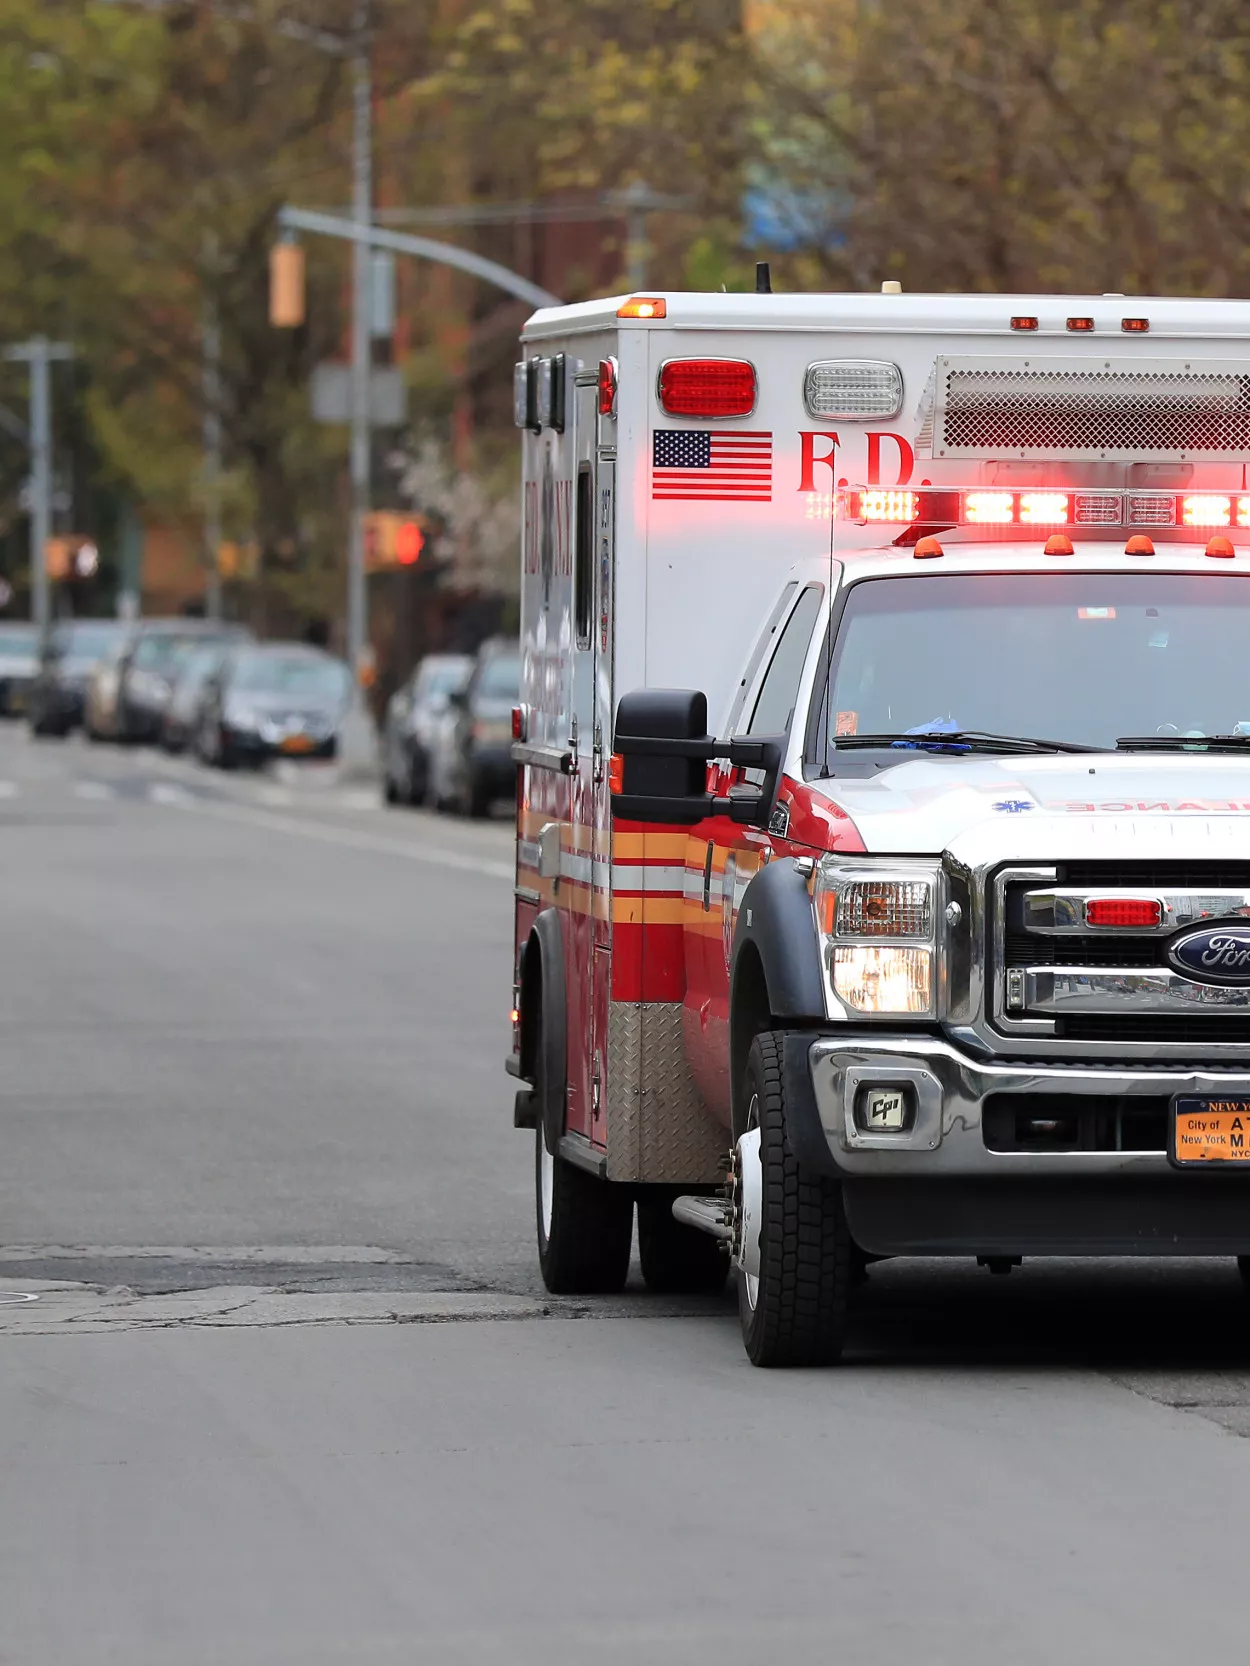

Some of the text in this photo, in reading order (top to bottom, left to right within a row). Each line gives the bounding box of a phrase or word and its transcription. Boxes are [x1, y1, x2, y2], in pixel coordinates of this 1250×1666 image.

[1208, 1102, 1239, 1112] NEW
[1187, 1120, 1220, 1131] City of
[1181, 1134, 1226, 1144] New York
[1231, 1150, 1250, 1158] NYC
